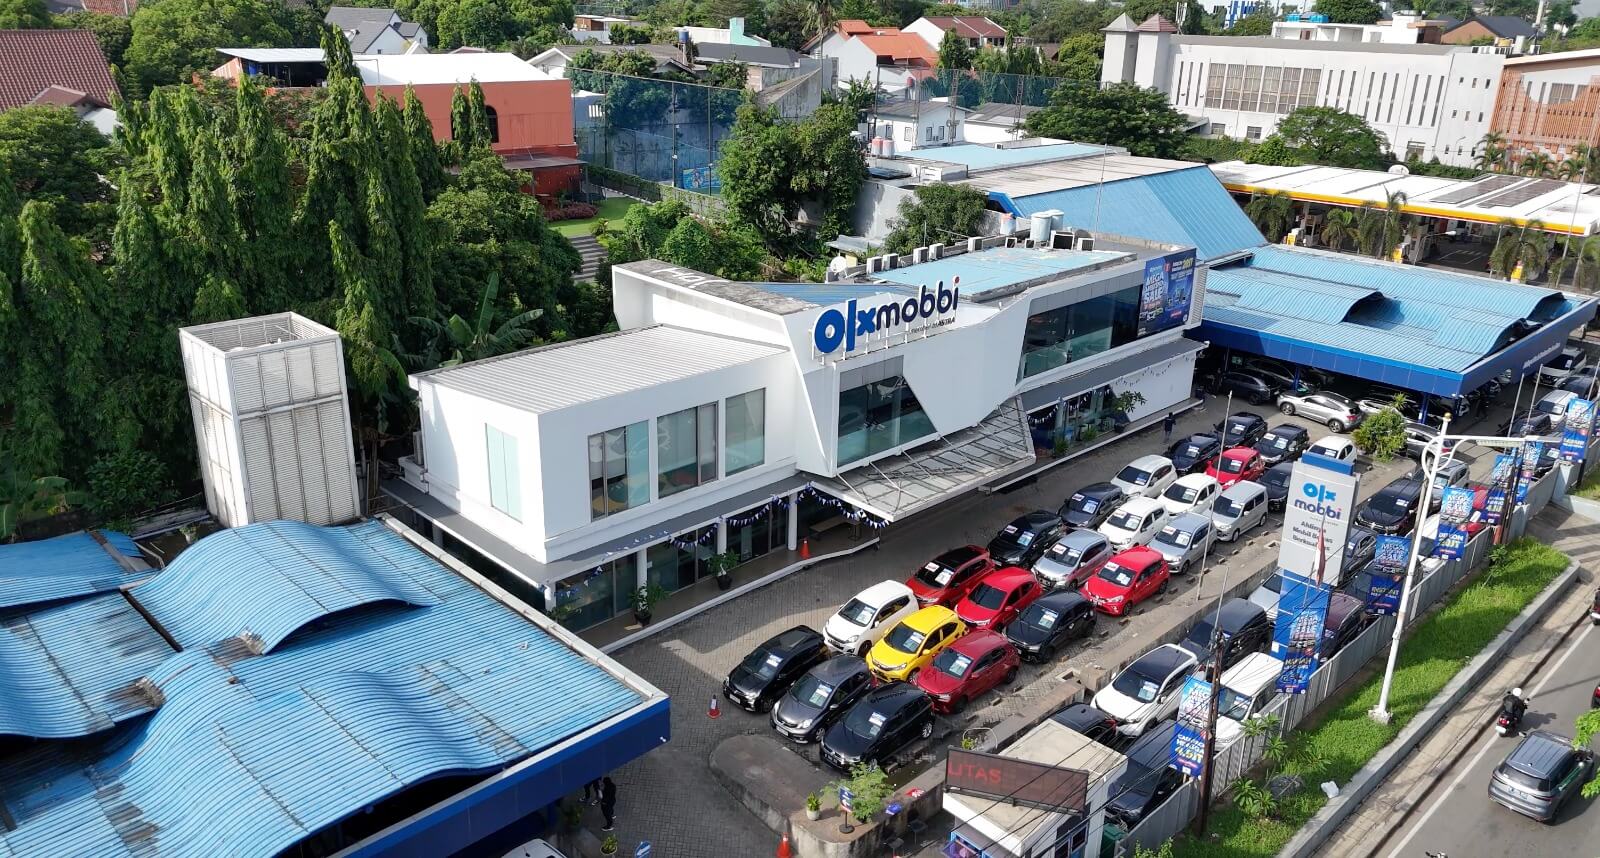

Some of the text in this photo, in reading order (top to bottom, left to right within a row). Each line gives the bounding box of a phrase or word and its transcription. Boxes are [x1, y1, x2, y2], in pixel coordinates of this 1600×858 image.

[1144, 288, 1164, 304] SALE
[1302, 482, 1337, 502] olx
[1294, 499, 1342, 520] mobbi
[1293, 526, 1311, 537] Mobil
